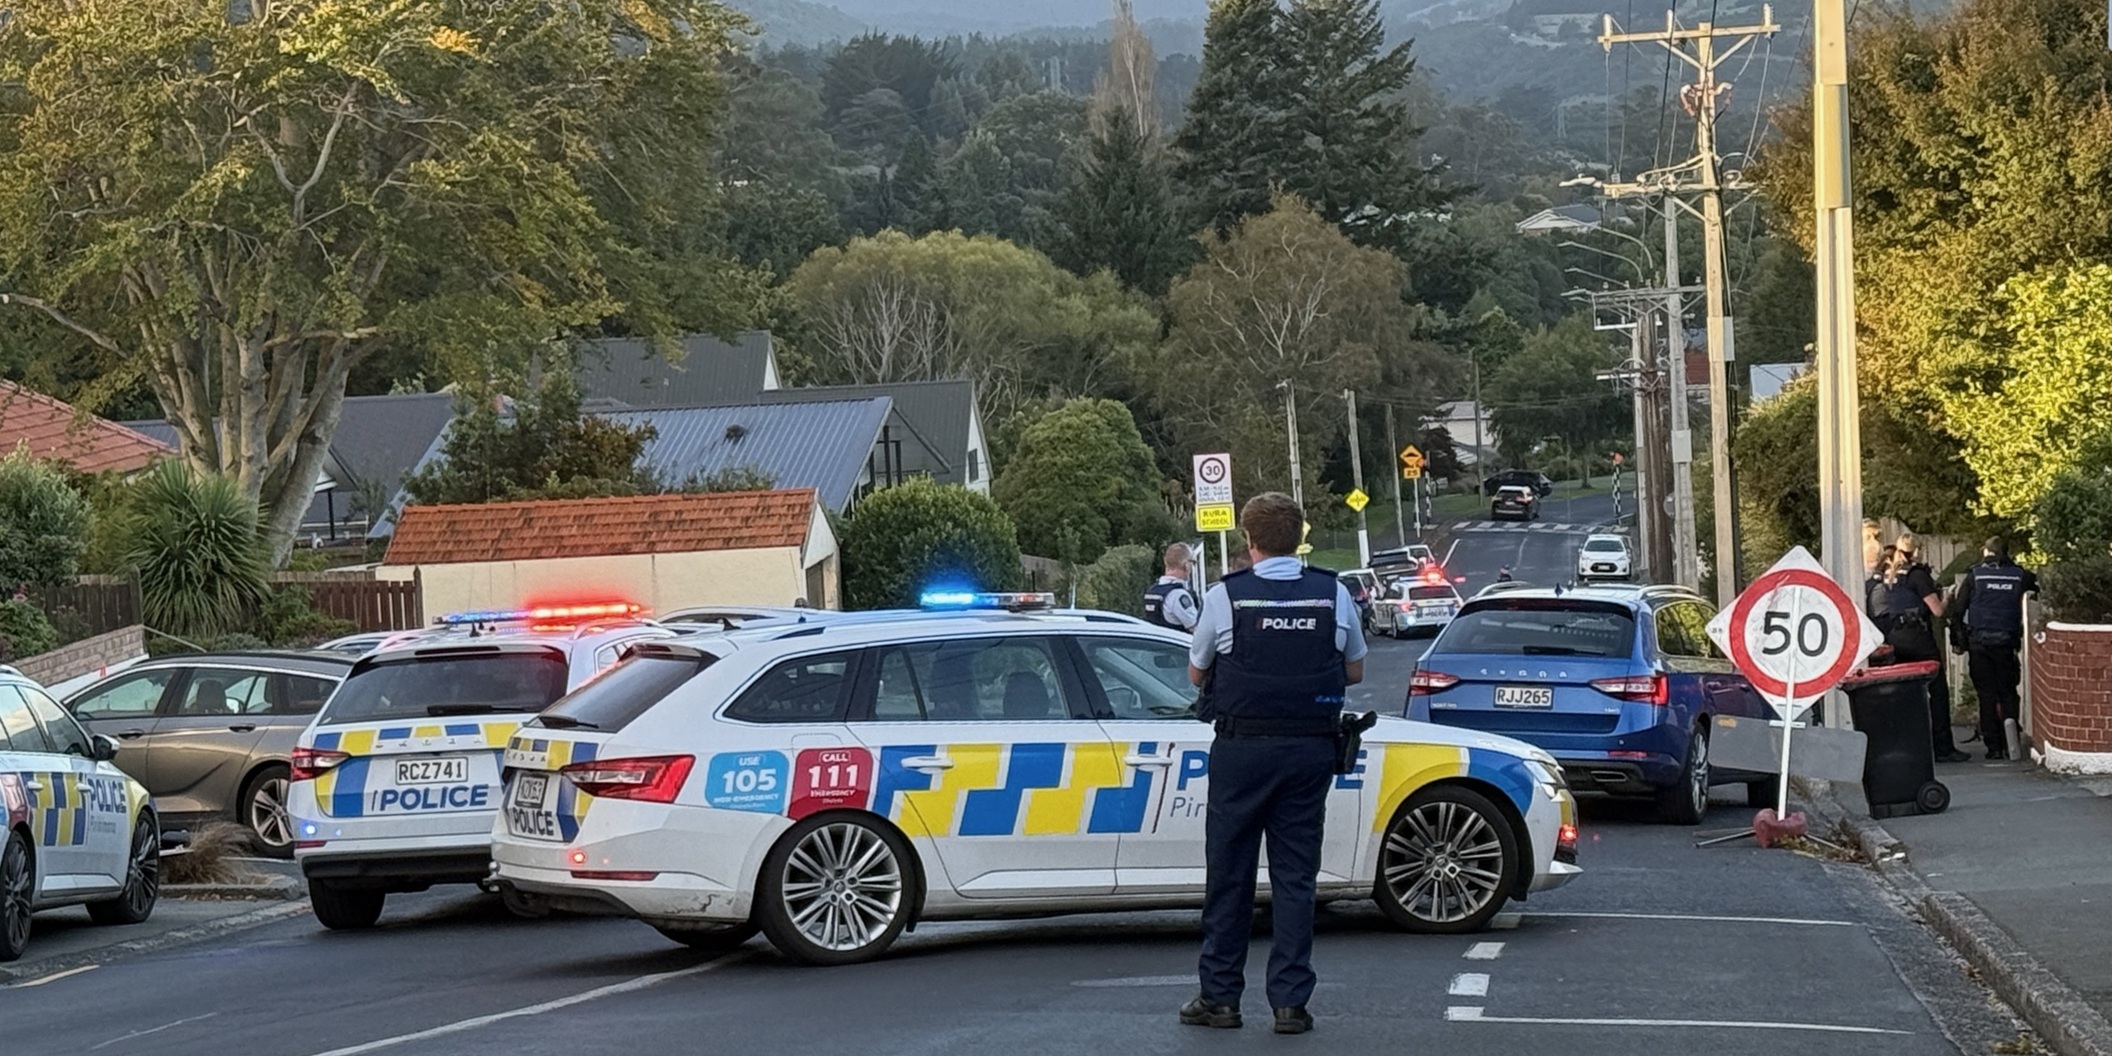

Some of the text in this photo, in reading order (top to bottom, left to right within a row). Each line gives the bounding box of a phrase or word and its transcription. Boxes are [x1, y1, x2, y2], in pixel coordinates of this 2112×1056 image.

[1205, 465, 1221, 476] 30
[1262, 618, 1316, 630] POLICE
[1762, 611, 1828, 657] 50
[1496, 688, 1550, 705] RJJ265
[738, 757, 761, 766] USE
[822, 752, 849, 763] CALL
[398, 761, 462, 781] RCZ741
[723, 768, 777, 793] 105
[809, 765, 859, 788] 111
[88, 778, 127, 814] POLICE
[379, 784, 489, 811] POLICE
[513, 808, 554, 836] POLICE
